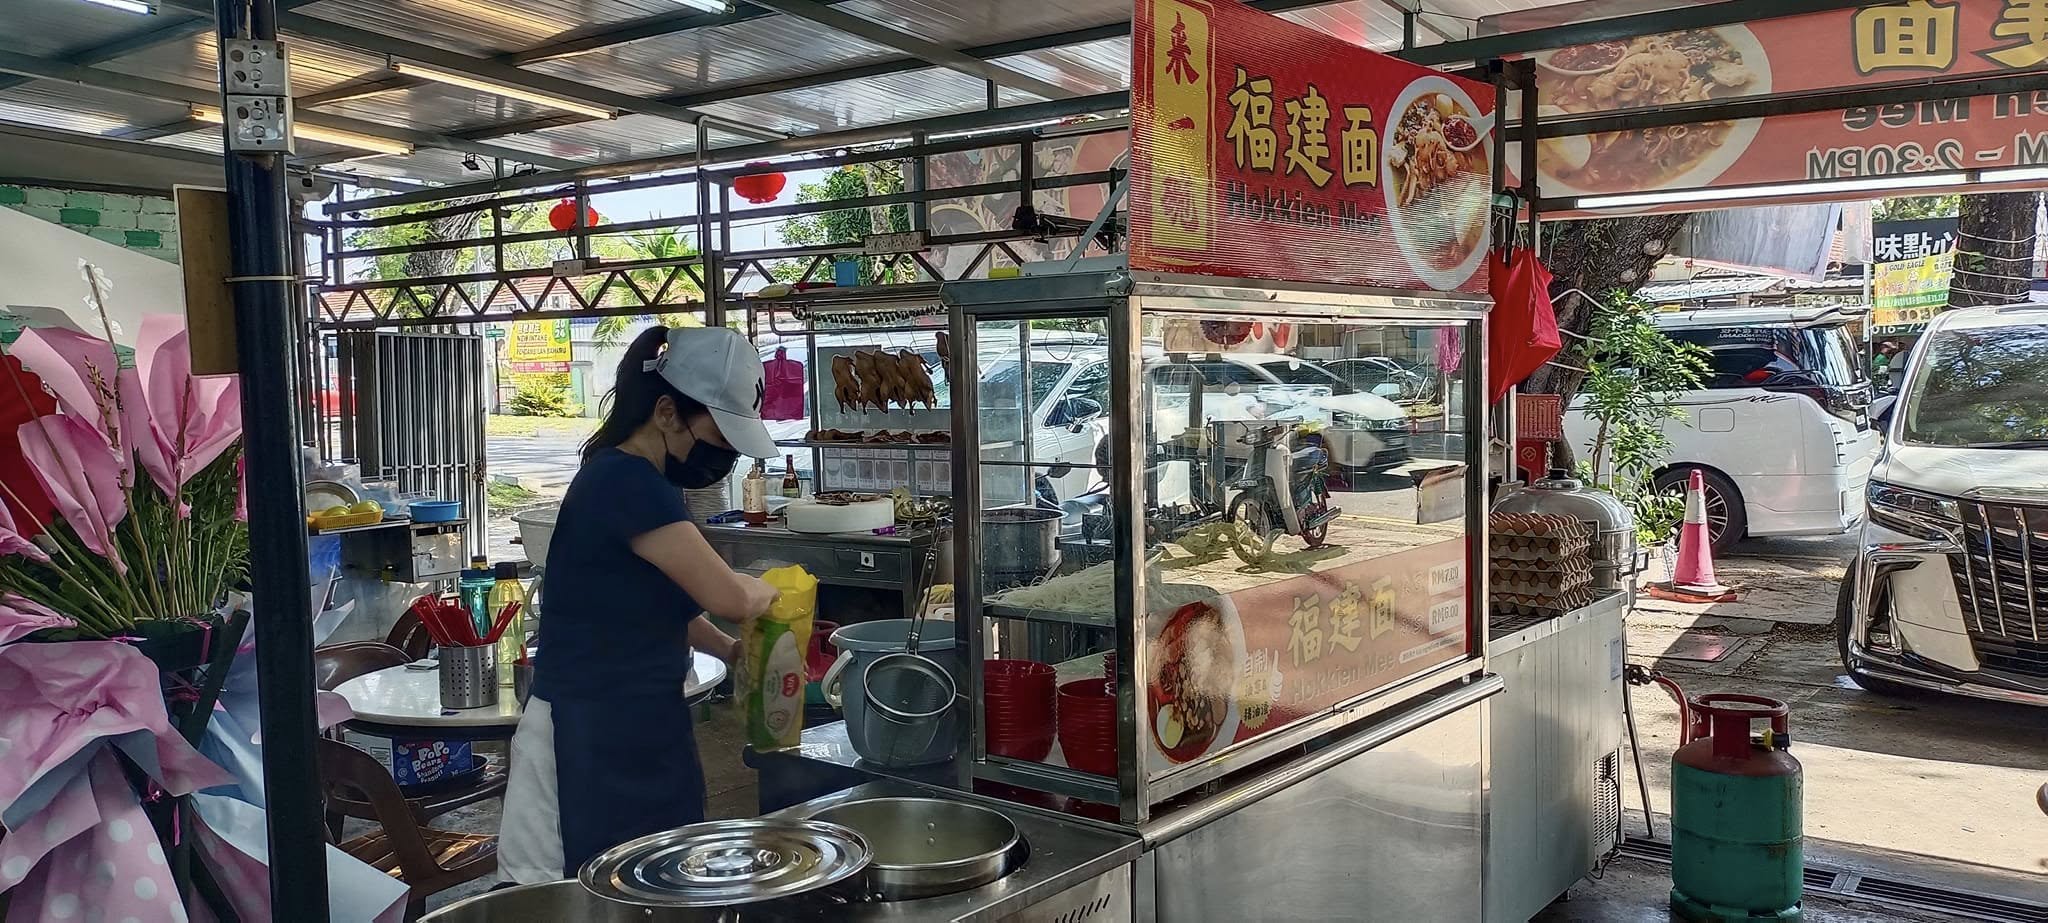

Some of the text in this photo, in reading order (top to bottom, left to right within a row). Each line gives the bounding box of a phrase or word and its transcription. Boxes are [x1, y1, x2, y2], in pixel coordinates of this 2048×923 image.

[1227, 67, 1379, 189] 福建面
[1227, 180, 1382, 237] Hokkien Mee
[1287, 574, 1396, 668] 福建面
[1431, 604, 1459, 625] RM6.00
